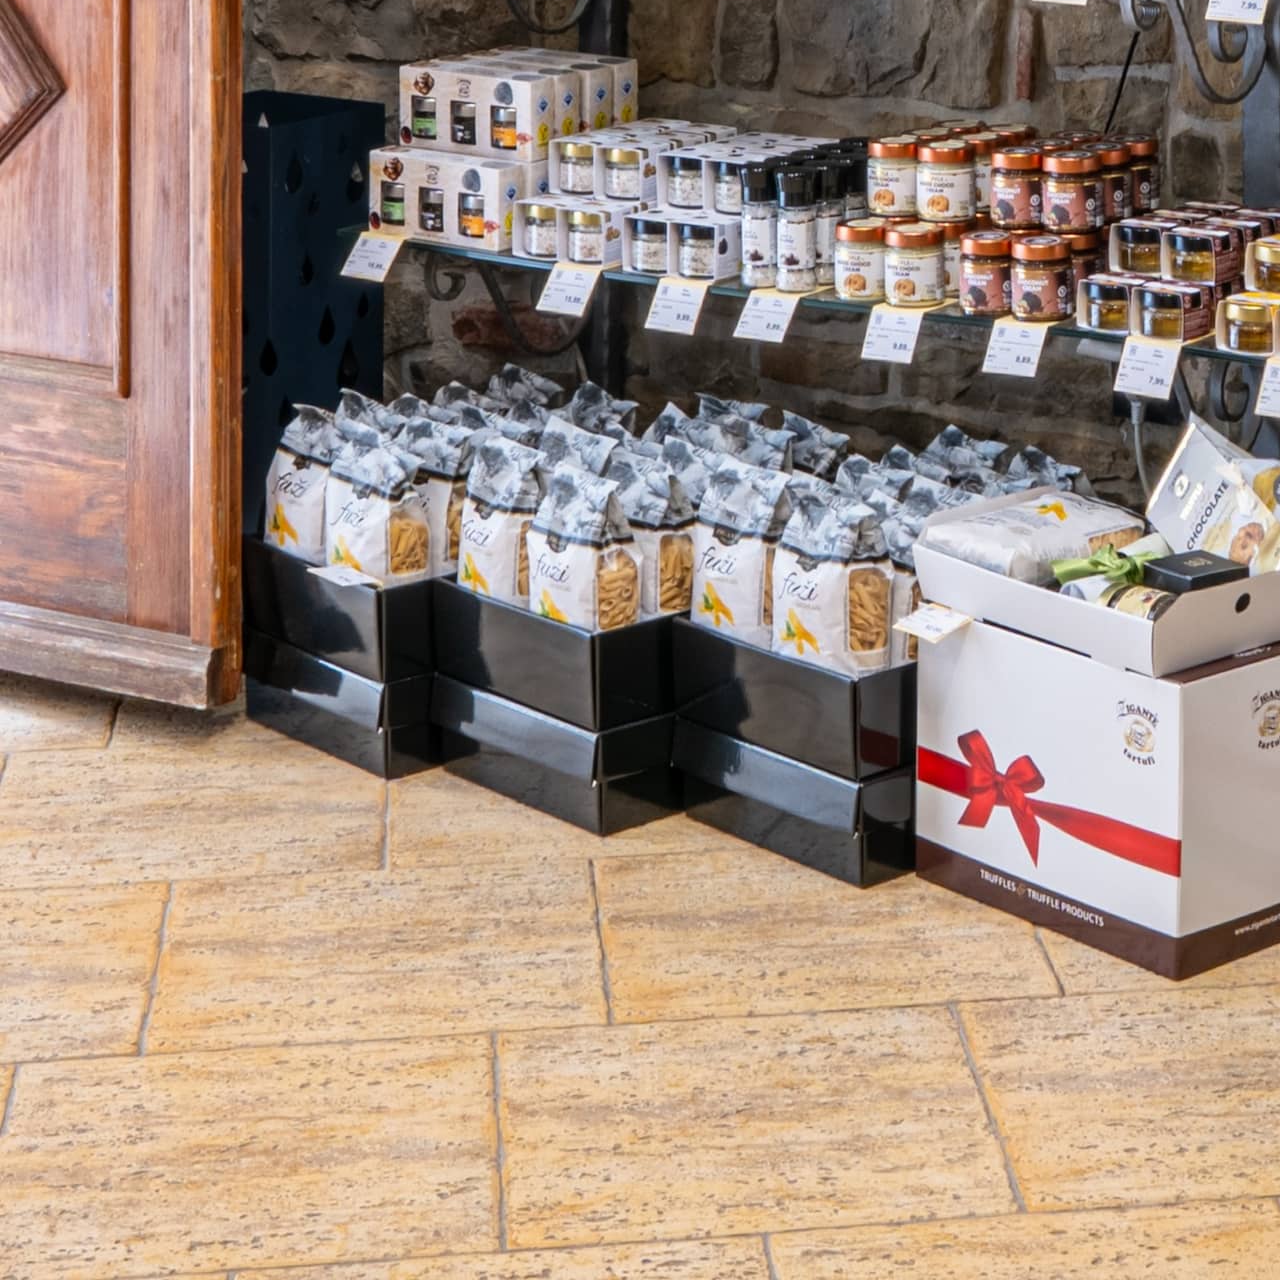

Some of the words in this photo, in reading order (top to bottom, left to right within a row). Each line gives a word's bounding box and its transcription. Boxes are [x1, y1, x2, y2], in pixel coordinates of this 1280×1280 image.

[1186, 479, 1230, 551] CHOCOLATE
[1123, 748, 1155, 766] tartufi
[979, 869, 1016, 891] TRUFFLES
[1027, 887, 1061, 911] TRUFFLE
[1061, 902, 1105, 927] PRODUCTS
